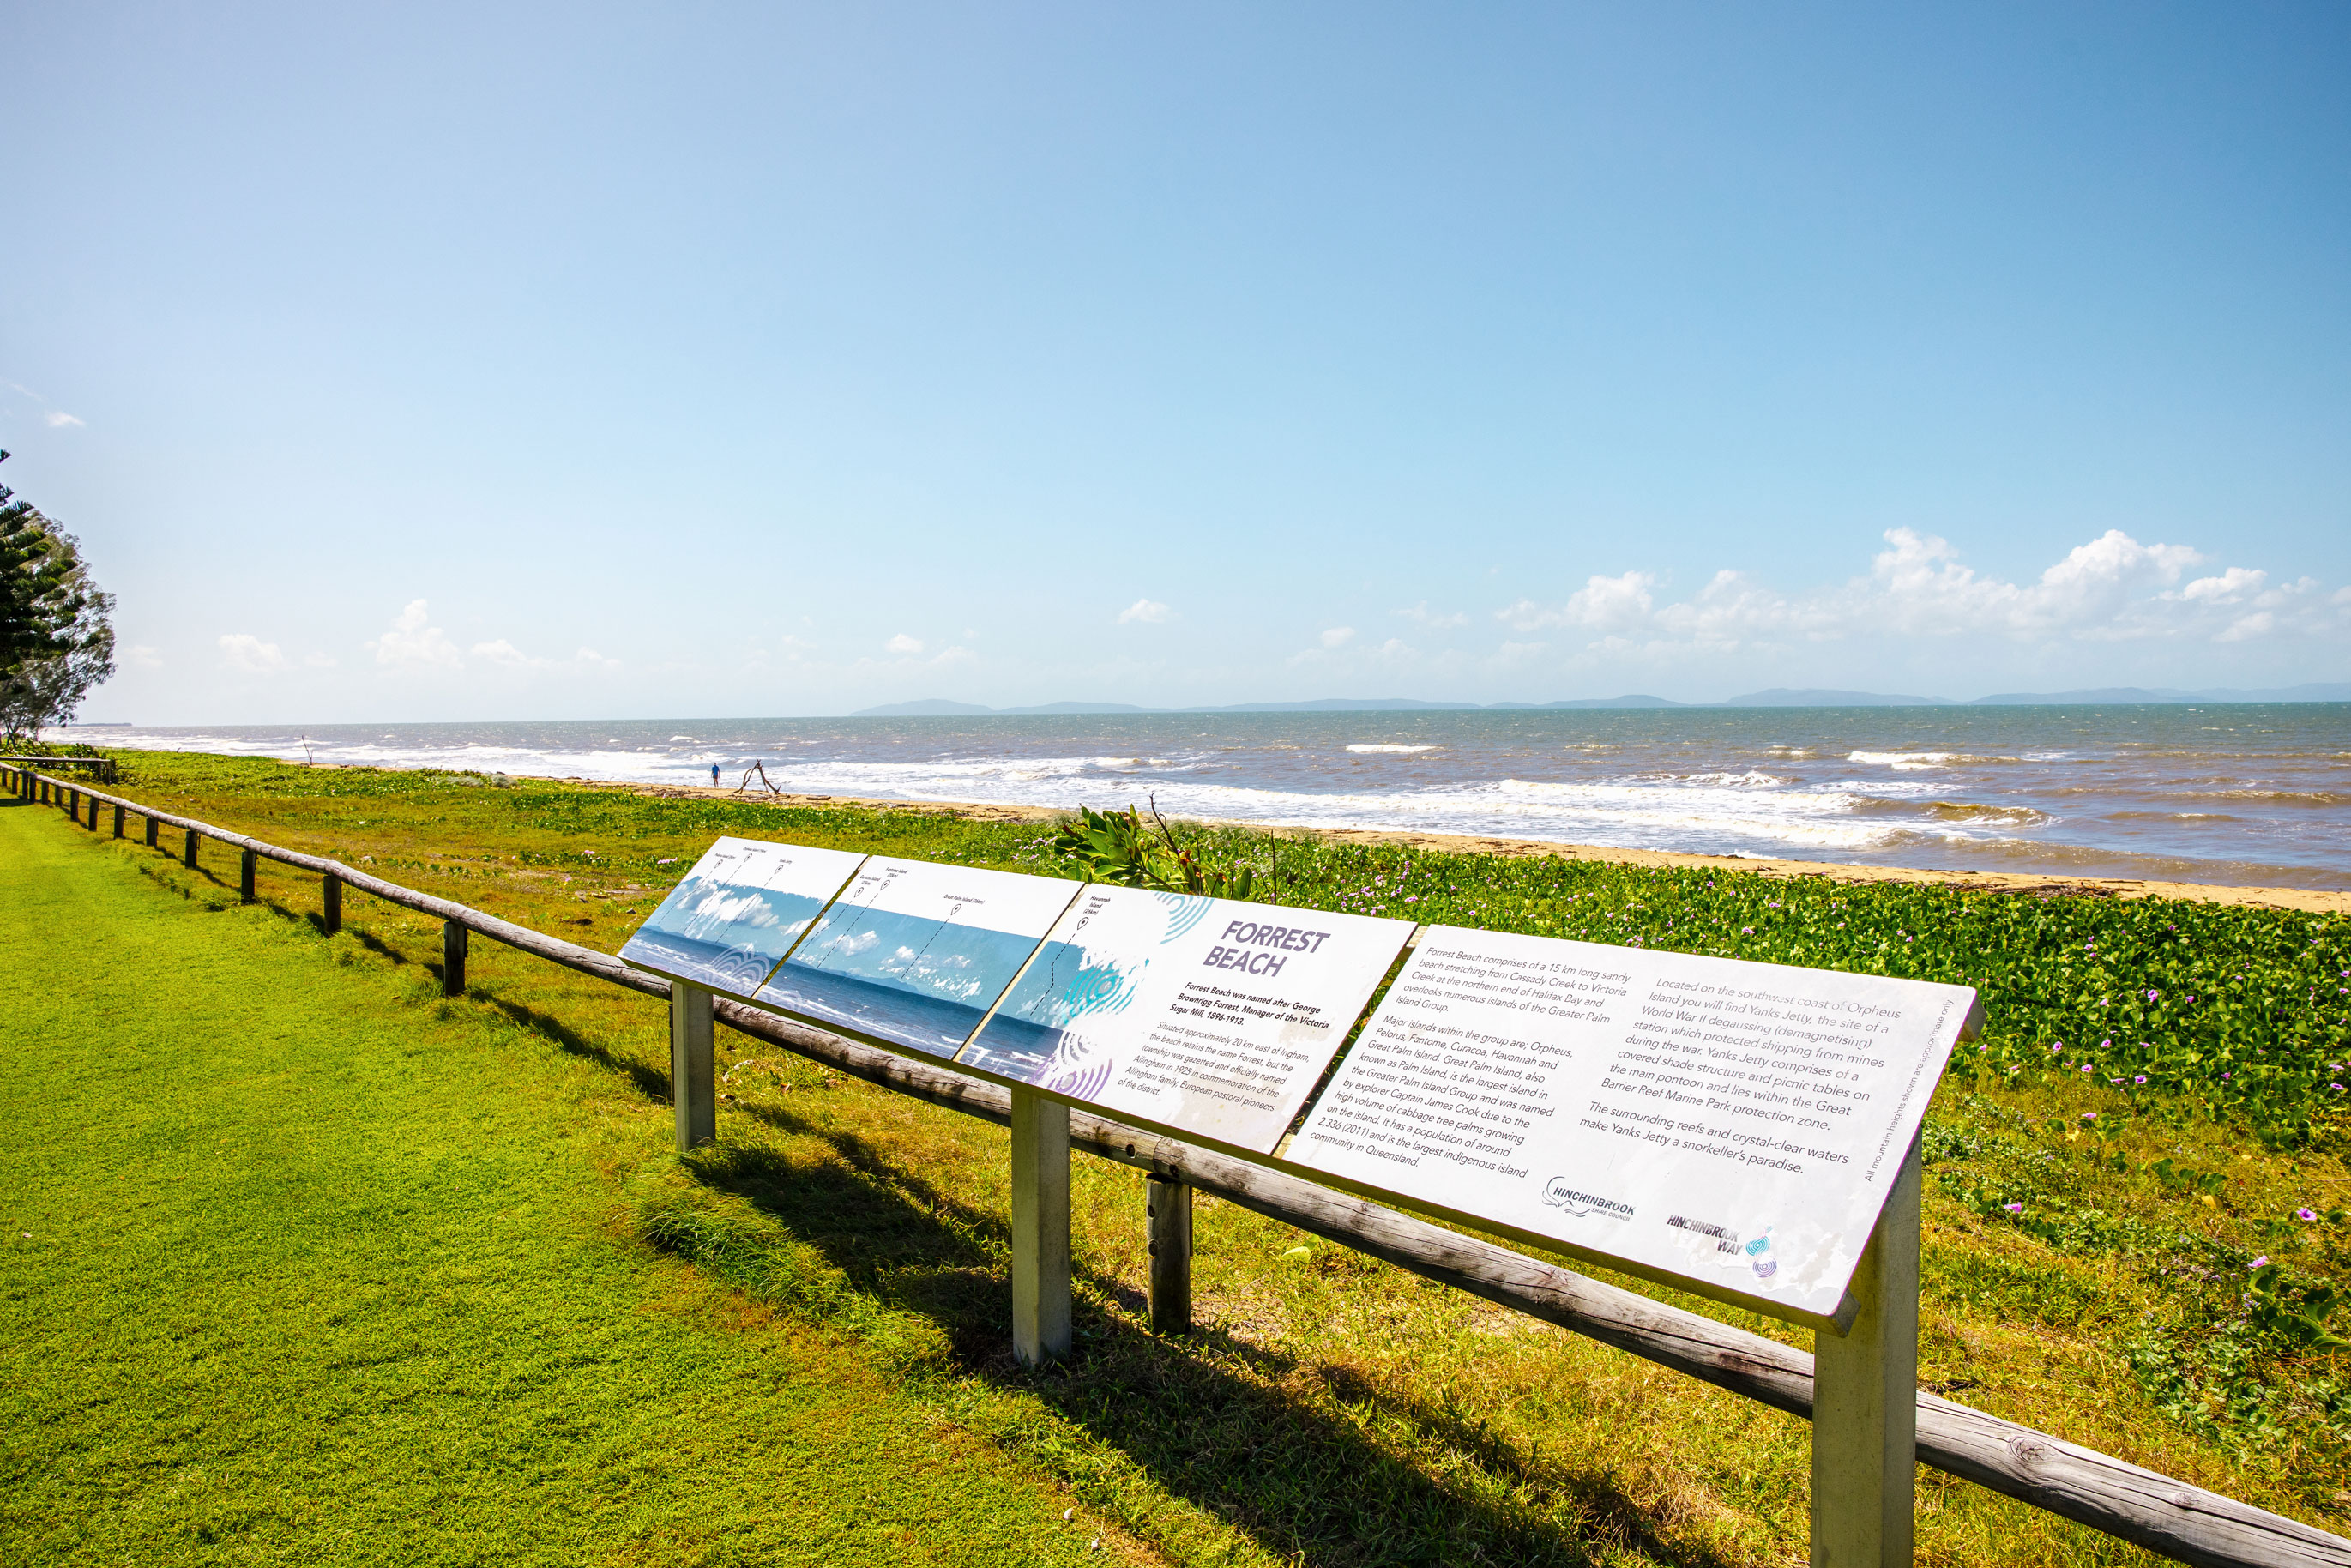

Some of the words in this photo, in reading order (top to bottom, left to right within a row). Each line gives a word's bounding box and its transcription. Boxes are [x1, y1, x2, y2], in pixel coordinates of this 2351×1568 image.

[1220, 920, 1331, 954] FORREST
[1203, 945, 1288, 977] BEACH
[1418, 958, 1444, 969] beach
[1444, 964, 1486, 978] stretching
[1487, 968, 1508, 979] from
[1510, 972, 1547, 986] Cassady
[1548, 977, 1576, 989] Creek
[1577, 982, 1588, 991] to
[1591, 983, 1627, 996] Victoria
[1426, 947, 1456, 958] Forrest
[1456, 950, 1482, 962] Beach
[1483, 956, 1528, 968] comprises
[1528, 961, 1541, 969] of
[1549, 963, 1561, 973] 15
[1561, 964, 1576, 974] km
[1577, 967, 1600, 980] long
[1600, 972, 1631, 984] sandy
[1185, 981, 1210, 992] Forrest
[1209, 986, 1232, 997] Beach
[1246, 995, 1274, 1004] named
[1272, 998, 1292, 1008] after
[1292, 1002, 1321, 1015] George
[1396, 995, 1422, 1006] Island
[1421, 999, 1449, 1013] Group.
[1403, 985, 1443, 997] overlooks
[1443, 992, 1486, 1004] numerous
[1486, 996, 1518, 1009] islands
[1518, 1001, 1532, 1010] of
[1530, 1003, 1546, 1013] the
[1548, 1005, 1585, 1019] Greater
[1585, 1011, 1610, 1023] Palm
[1411, 971, 1436, 981] Creek
[1446, 976, 1461, 986] the
[1462, 980, 1499, 992] northern
[1500, 986, 1520, 994] end
[1519, 987, 1533, 996] of
[1531, 989, 1563, 1001] Halifax
[1564, 993, 1583, 1006] Bay
[1583, 998, 1605, 1008] and
[1169, 1004, 1190, 1015] Sugar
[1190, 1008, 1205, 1018] Mill,
[1207, 1011, 1244, 1026] 1896-1913.
[1177, 992, 1213, 1008] Brownrigg
[1213, 999, 1239, 1012] Forrest,
[1241, 1005, 1275, 1019] Manager
[1284, 1014, 1298, 1023] the
[1299, 1016, 1329, 1029] Victoria
[1642, 1005, 1674, 1018] World
[1675, 1010, 1697, 1022] War
[1698, 1014, 1708, 1023] II
[1708, 1016, 1772, 1036] degaussing
[1774, 1025, 1872, 1051] (demagnetising)
[1649, 991, 1681, 1004] Island
[1679, 998, 1702, 1007] you
[1703, 1000, 1724, 1010] will
[1724, 1001, 1748, 1013] find
[1750, 1004, 1781, 1018] Yanks
[1781, 1010, 1812, 1025] Jetty,
[1817, 1015, 1837, 1027] the
[1839, 1018, 1862, 1030] site
[1865, 1022, 1880, 1032] of
[1149, 1032, 1160, 1041] the
[1160, 1034, 1182, 1046] beach
[1181, 1041, 1204, 1052] retains
[1204, 1045, 1217, 1054] the
[1216, 1050, 1237, 1059] name
[1237, 1052, 1263, 1067] Forrest,
[1265, 1058, 1280, 1069] but
[1280, 1062, 1293, 1072] the
[1156, 1021, 1186, 1034] Situated
[1184, 1028, 1232, 1046] approximately
[1231, 1037, 1244, 1046] 20
[1242, 1039, 1254, 1049] km
[1254, 1045, 1271, 1053] east
[1270, 1046, 1282, 1055] of
[1280, 1048, 1309, 1063] Ingham,
[1375, 1027, 1406, 1042] Pelorus,
[1408, 1034, 1447, 1050] Fantome,
[1450, 1041, 1488, 1058] Curacoa,
[1491, 1049, 1537, 1065] Havannah
[1538, 1060, 1559, 1070] and
[1383, 1015, 1408, 1028] Major
[1408, 1019, 1437, 1032] islands
[1438, 1026, 1463, 1037] within
[1465, 1029, 1480, 1040] the
[1480, 1034, 1509, 1047] group
[1510, 1040, 1528, 1050] are;
[1530, 1041, 1572, 1058] Orpheus,
[1118, 1077, 1128, 1086] of
[1125, 1079, 1137, 1089] the
[1136, 1083, 1160, 1095] district.
[1124, 1066, 1158, 1081] Allingham
[1157, 1074, 1179, 1088] family,
[1179, 1080, 1213, 1095] European
[1211, 1090, 1245, 1103] pastoral
[1240, 1097, 1275, 1112] pioneers
[1600, 1077, 1637, 1092] Barrier
[1637, 1084, 1666, 1097] Reef
[1665, 1089, 1703, 1106] Marine
[1705, 1097, 1731, 1111] Park
[1731, 1105, 1794, 1123] protection
[1797, 1117, 1830, 1131] zone.
[1865, 1170, 1875, 1182] All
[1872, 1132, 1893, 1169] mountain
[1887, 1103, 1906, 1131] heights
[1902, 1076, 1918, 1103] shown
[1914, 1063, 1924, 1076] are
[1921, 1016, 1945, 1062] approximate
[1943, 999, 1955, 1016] only
[1310, 1131, 1355, 1151] community
[1355, 1142, 1364, 1151] in
[1365, 1144, 1420, 1167] Queensland.
[1317, 1116, 1342, 1130] 2,336
[1341, 1123, 1370, 1138] (2011)
[1368, 1132, 1388, 1142] and
[1387, 1134, 1396, 1144] is
[1396, 1137, 1411, 1148] the
[1412, 1140, 1444, 1157] largest
[1444, 1149, 1496, 1170] indigenous
[1497, 1162, 1528, 1178] island
[1579, 1119, 1608, 1131] make
[1612, 1123, 1641, 1138] Yanks
[1642, 1130, 1671, 1147] Jetty
[1681, 1141, 1746, 1161] snorkeller's
[1746, 1155, 1803, 1173] paradise.
[1589, 1101, 1608, 1114] The
[1610, 1108, 1675, 1131] surrounding
[1676, 1122, 1705, 1134] reefs
[1707, 1128, 1732, 1139] and
[1732, 1133, 1805, 1154] crystal-clear
[1807, 1149, 1849, 1164] waters
[1552, 1186, 1635, 1215] HINCHINBROOK
[1590, 1207, 1607, 1216] SHIRE
[1607, 1211, 1631, 1222] COUNCIL
[1667, 1215, 1741, 1242] HINCHINBROOK
[1717, 1239, 1743, 1256] WAY
